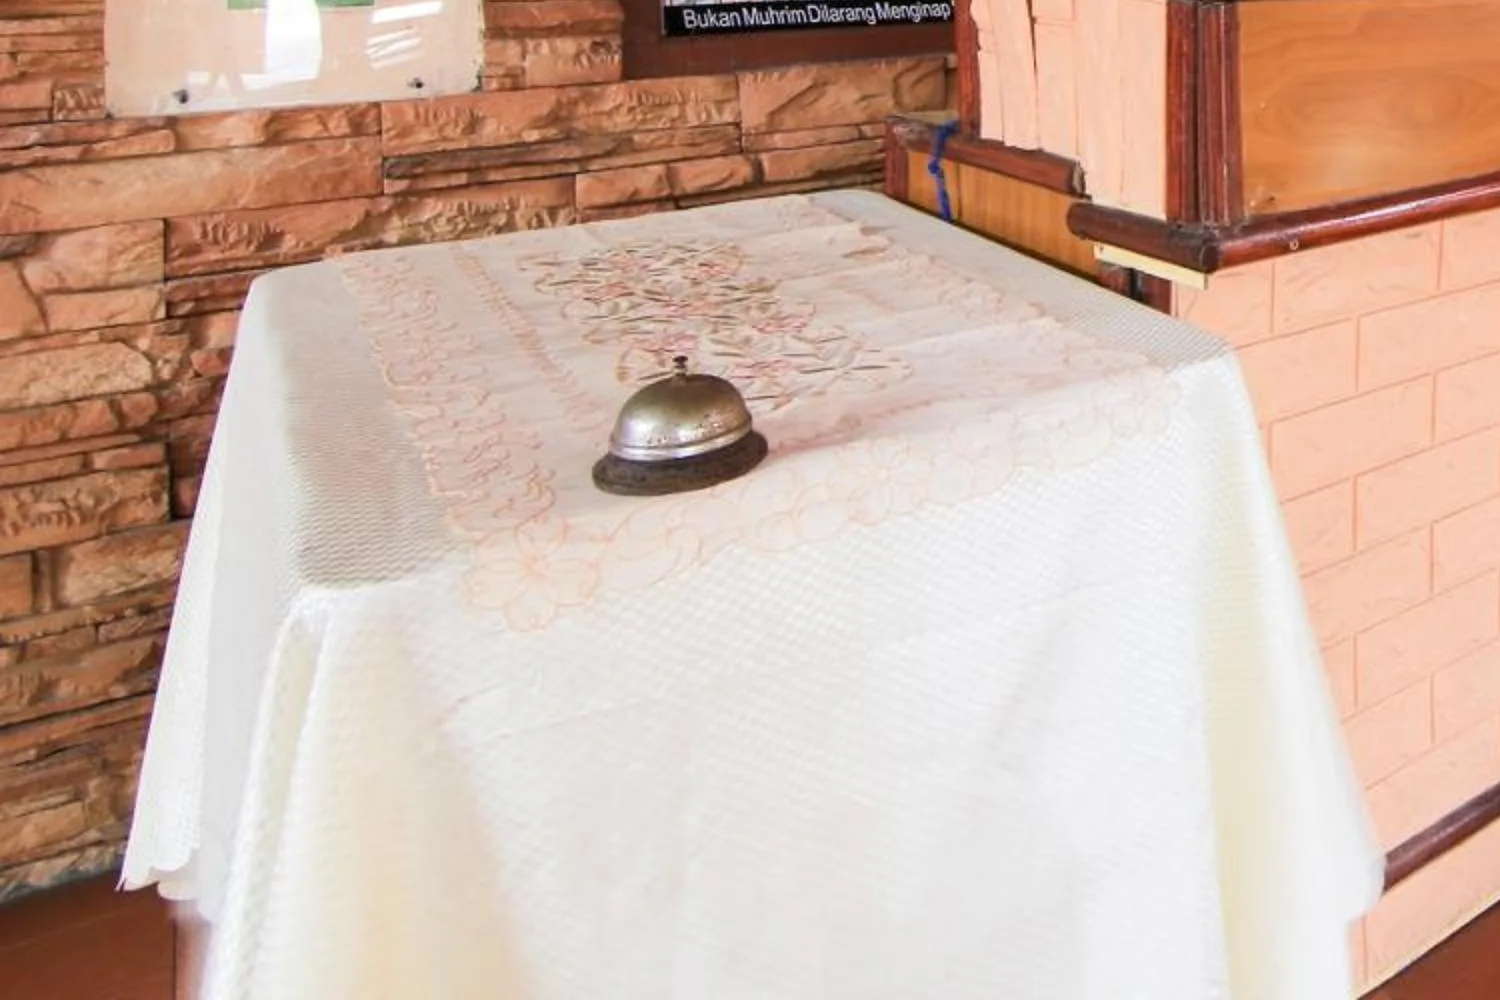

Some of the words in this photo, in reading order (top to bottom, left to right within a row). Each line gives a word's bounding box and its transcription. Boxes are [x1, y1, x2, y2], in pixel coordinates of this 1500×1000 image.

[683, 8, 741, 29] Bukan
[743, 6, 806, 26] Muhrim
[809, 3, 877, 25] Dilarang
[877, 1, 951, 23] Menginap
